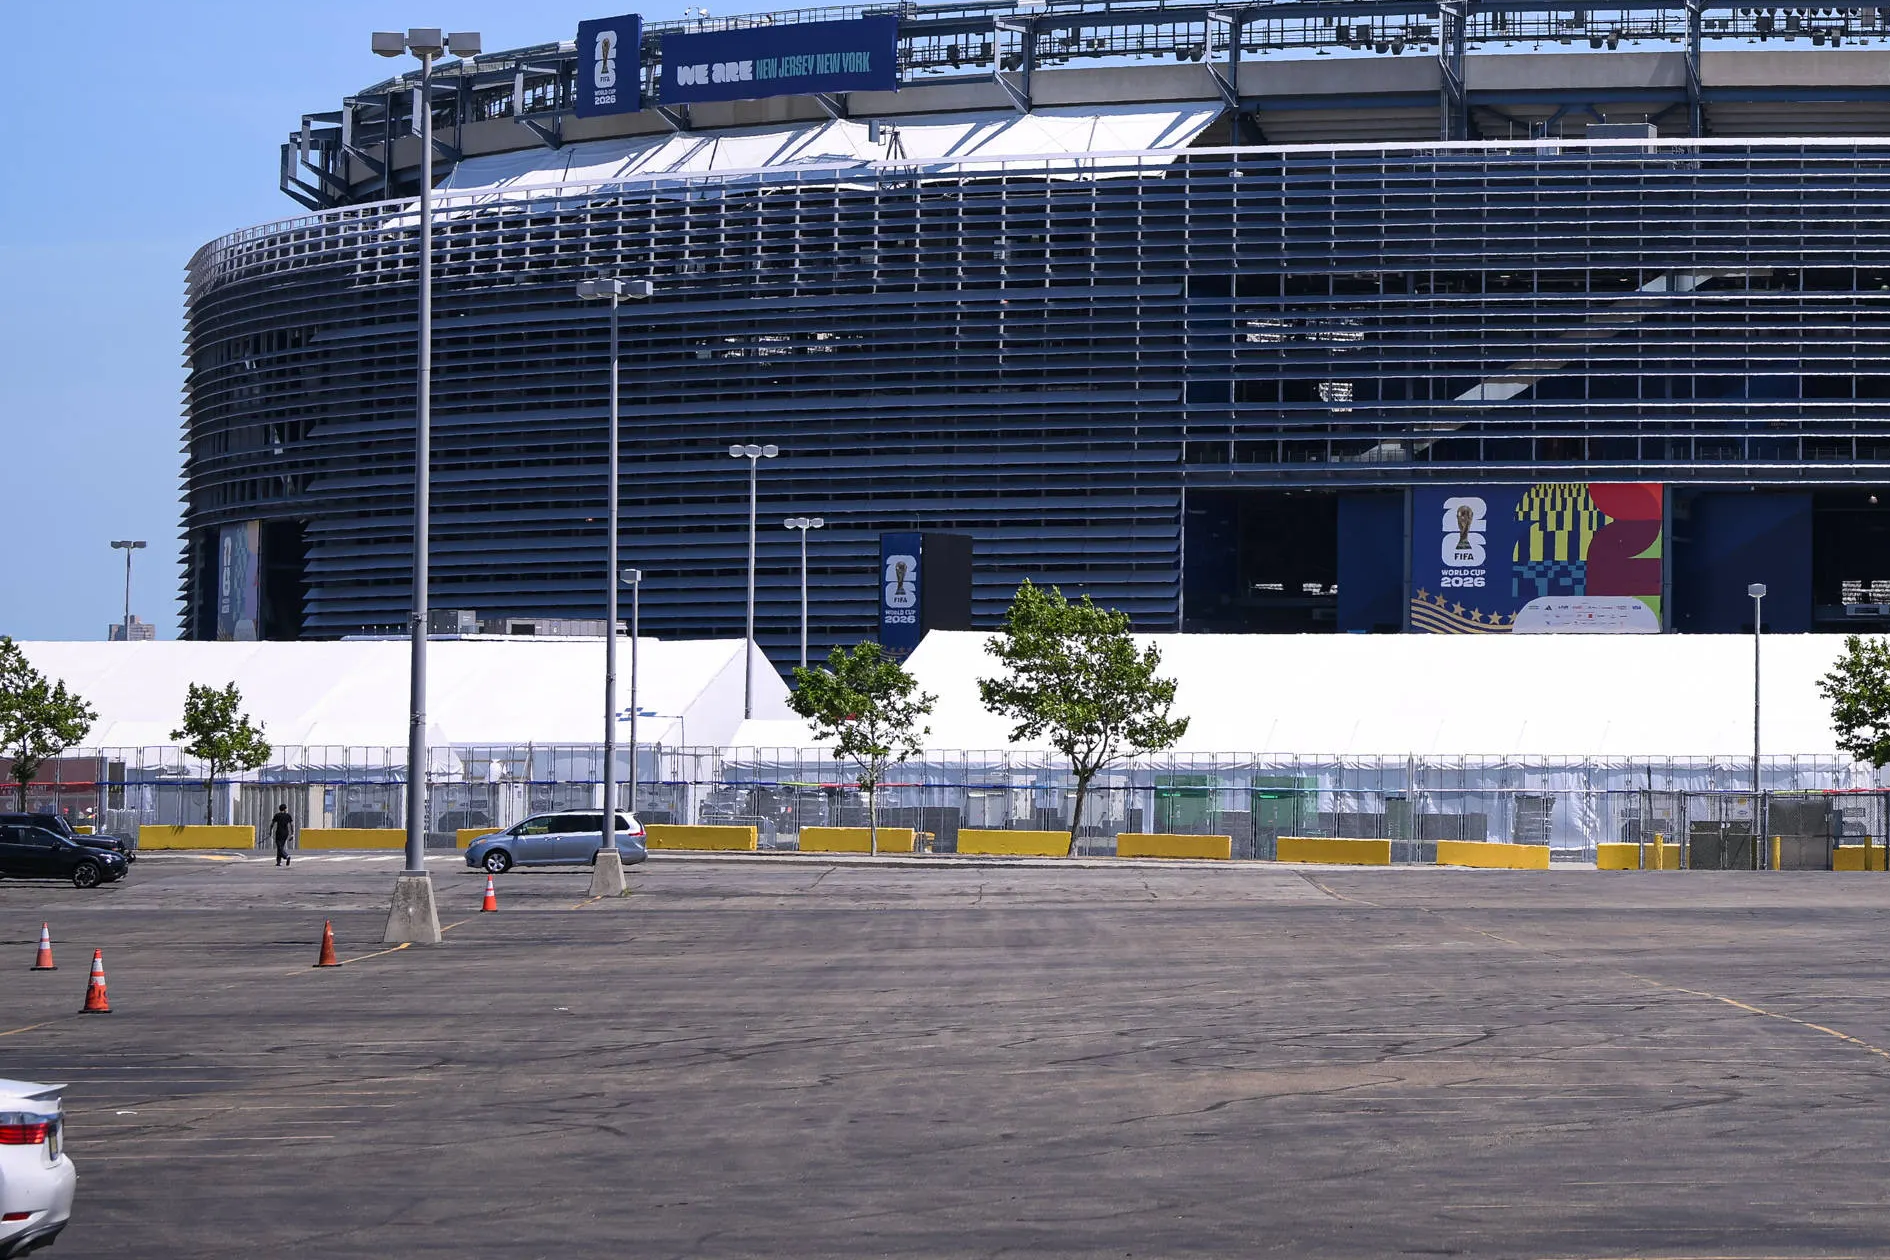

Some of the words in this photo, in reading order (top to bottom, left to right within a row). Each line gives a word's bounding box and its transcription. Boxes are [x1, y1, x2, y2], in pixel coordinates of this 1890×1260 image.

[676, 63, 708, 87] WE
[712, 60, 753, 84] ARE
[756, 57, 777, 80] NEW
[778, 54, 816, 78] JERSEY
[816, 52, 841, 75] NEW
[842, 52, 871, 73] YORK
[594, 95, 616, 105] 2026
[1454, 553, 1474, 561] FIFA
[1440, 577, 1486, 587] 2026
[885, 615, 916, 624] 2026
